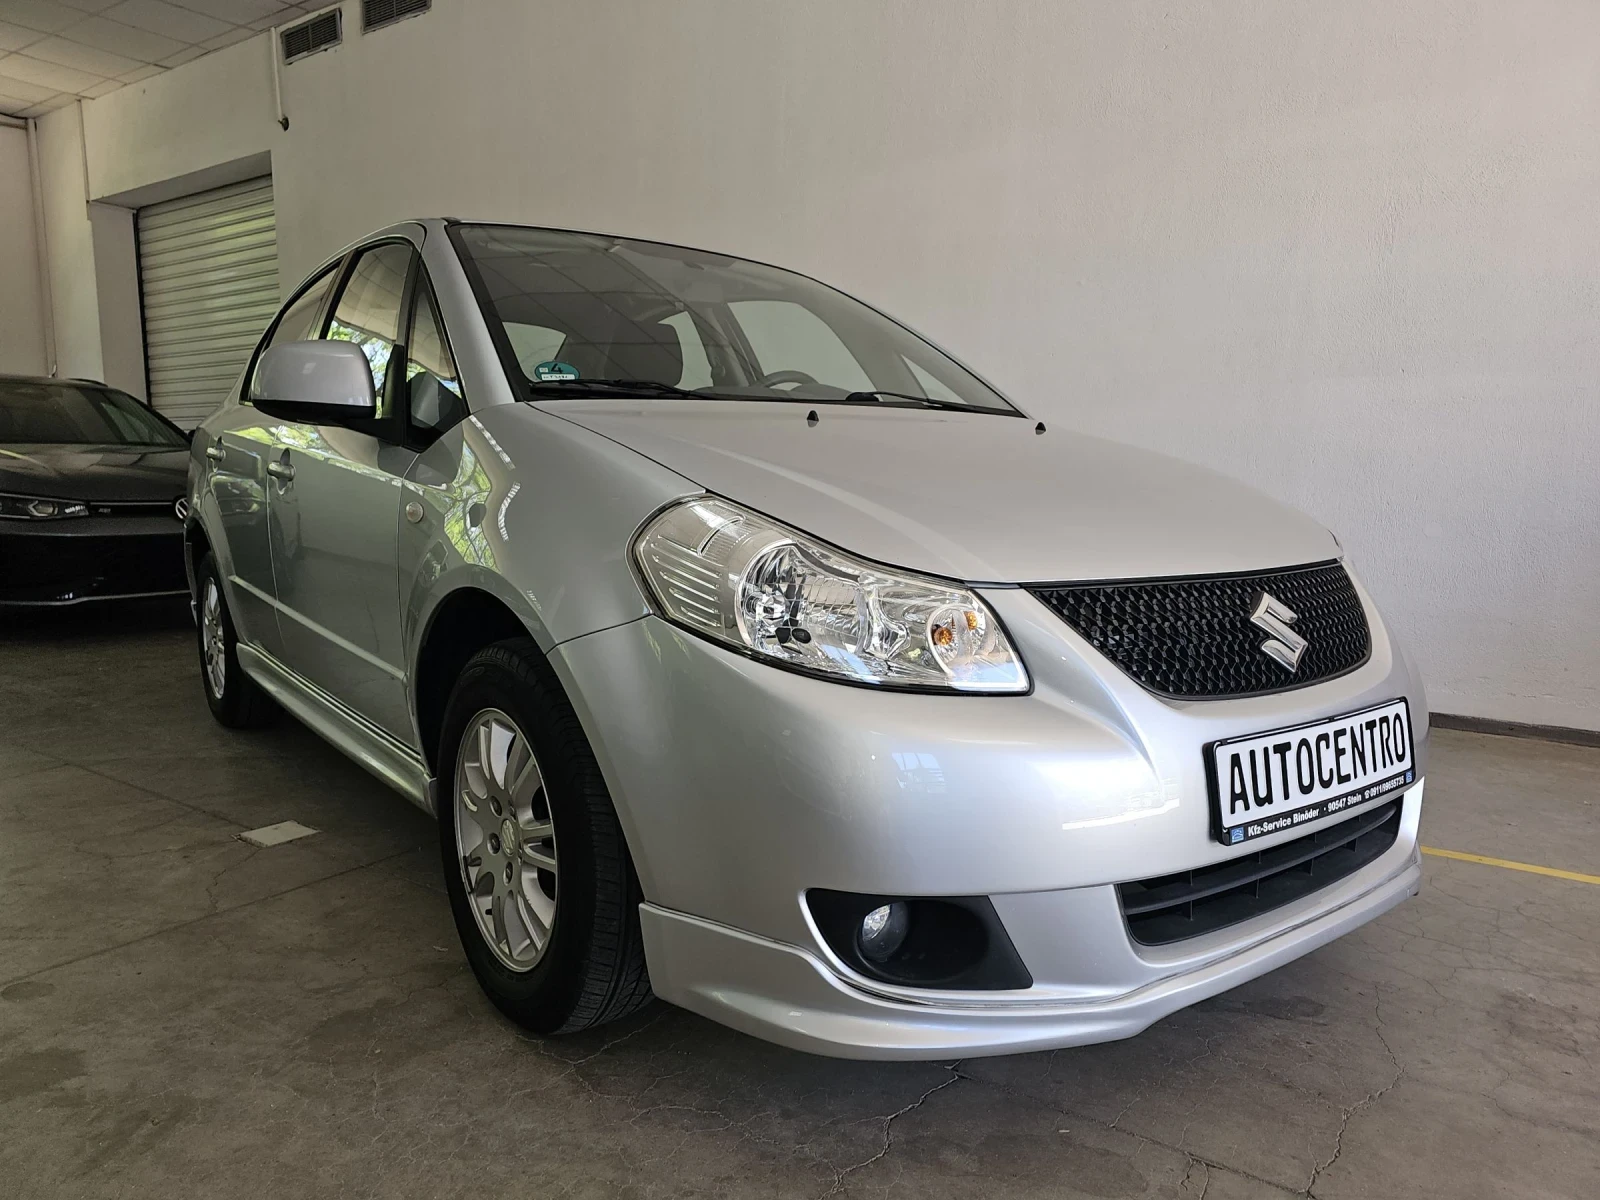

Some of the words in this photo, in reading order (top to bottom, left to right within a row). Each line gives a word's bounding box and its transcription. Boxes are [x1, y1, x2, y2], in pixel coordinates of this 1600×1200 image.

[1230, 712, 1406, 815] AUTOCENTRO
[1247, 818, 1291, 837] Kfz-Service
[1293, 807, 1320, 822] Binöder
[1327, 798, 1346, 812] 90547
[1347, 792, 1362, 805] Stein
